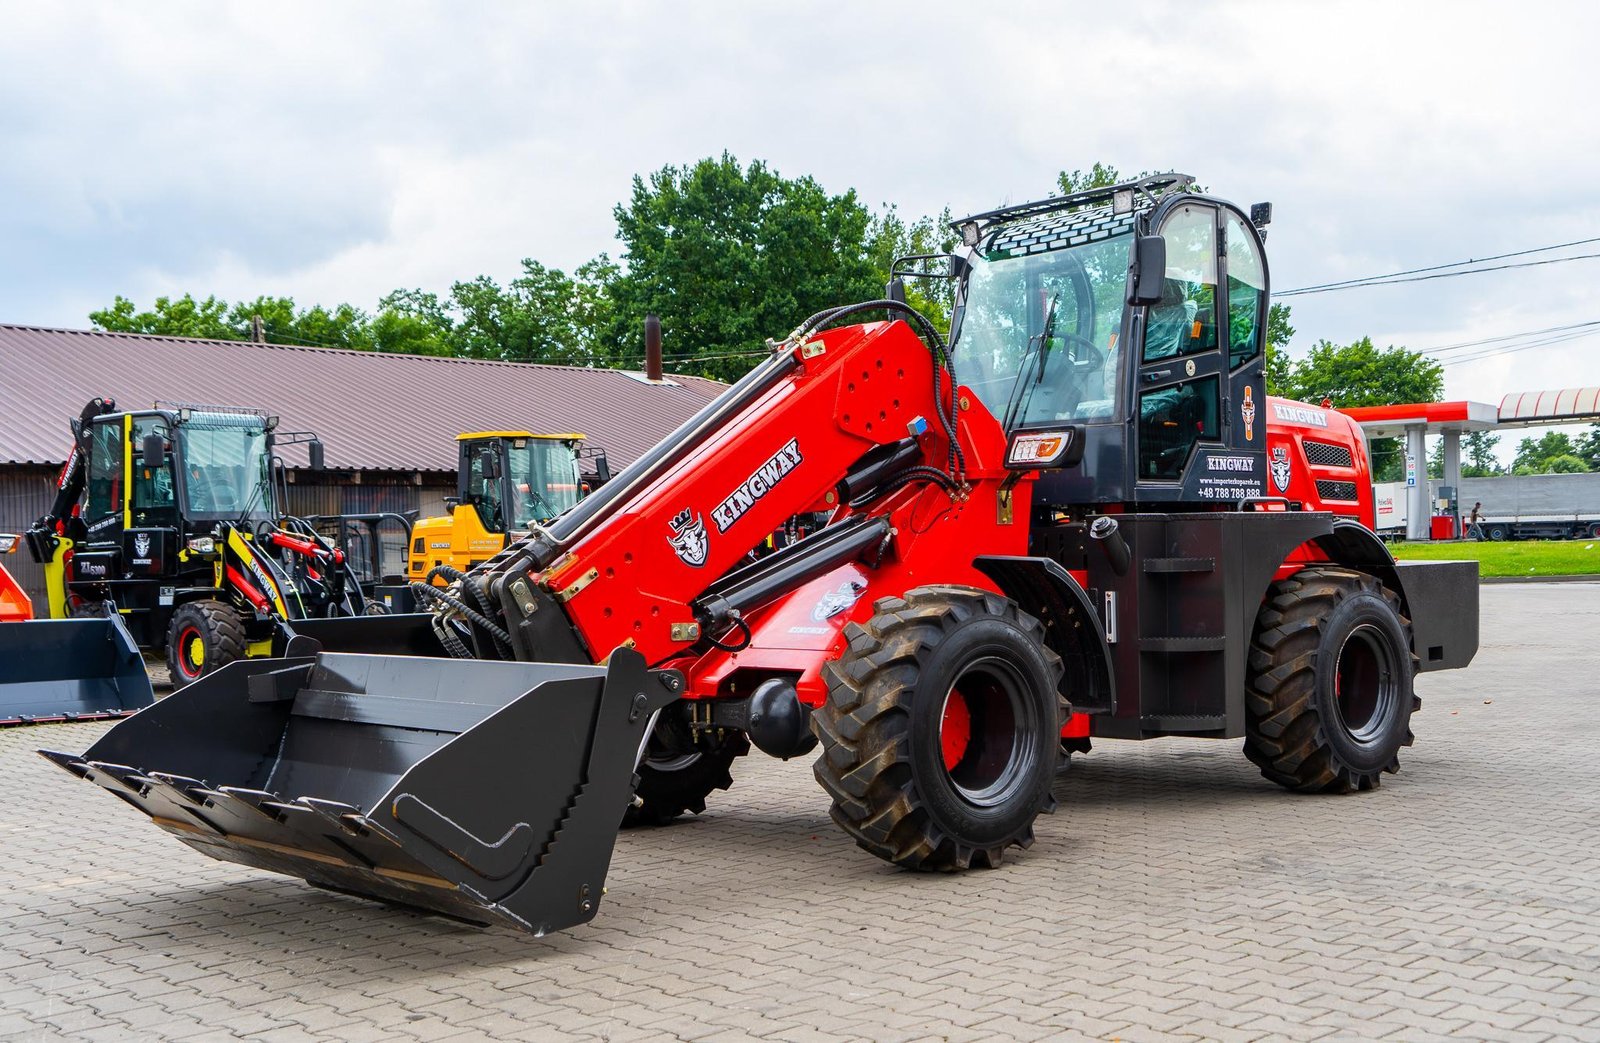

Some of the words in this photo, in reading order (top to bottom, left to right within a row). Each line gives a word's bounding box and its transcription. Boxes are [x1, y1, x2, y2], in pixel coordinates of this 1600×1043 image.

[1273, 404, 1328, 427] KINGWAY
[1207, 457, 1254, 472] KINGWAY
[711, 439, 803, 533] KINGWAY
[1198, 488, 1214, 498] +48
[1215, 488, 1230, 499] 788
[1231, 488, 1245, 499] 788
[1246, 489, 1261, 498] 888
[250, 557, 277, 601] KINGWAY
